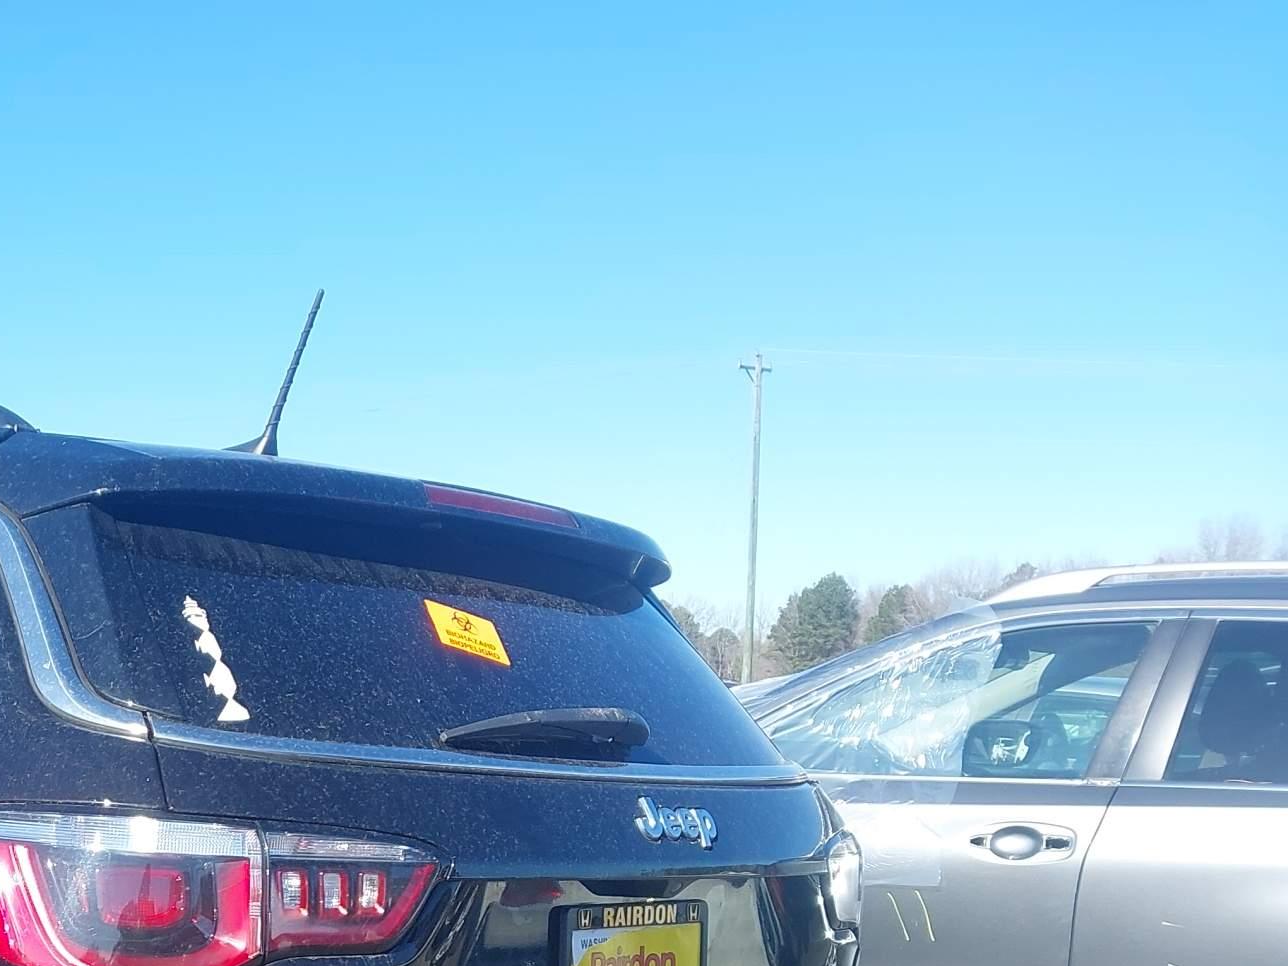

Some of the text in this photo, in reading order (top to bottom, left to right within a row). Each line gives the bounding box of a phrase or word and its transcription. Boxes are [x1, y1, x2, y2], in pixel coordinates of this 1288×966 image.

[445, 629, 497, 651] BIOHAZARD
[448, 638, 501, 660] BIOPELIGRO
[634, 796, 718, 850] Jeep
[602, 904, 678, 928] RAIRDON
